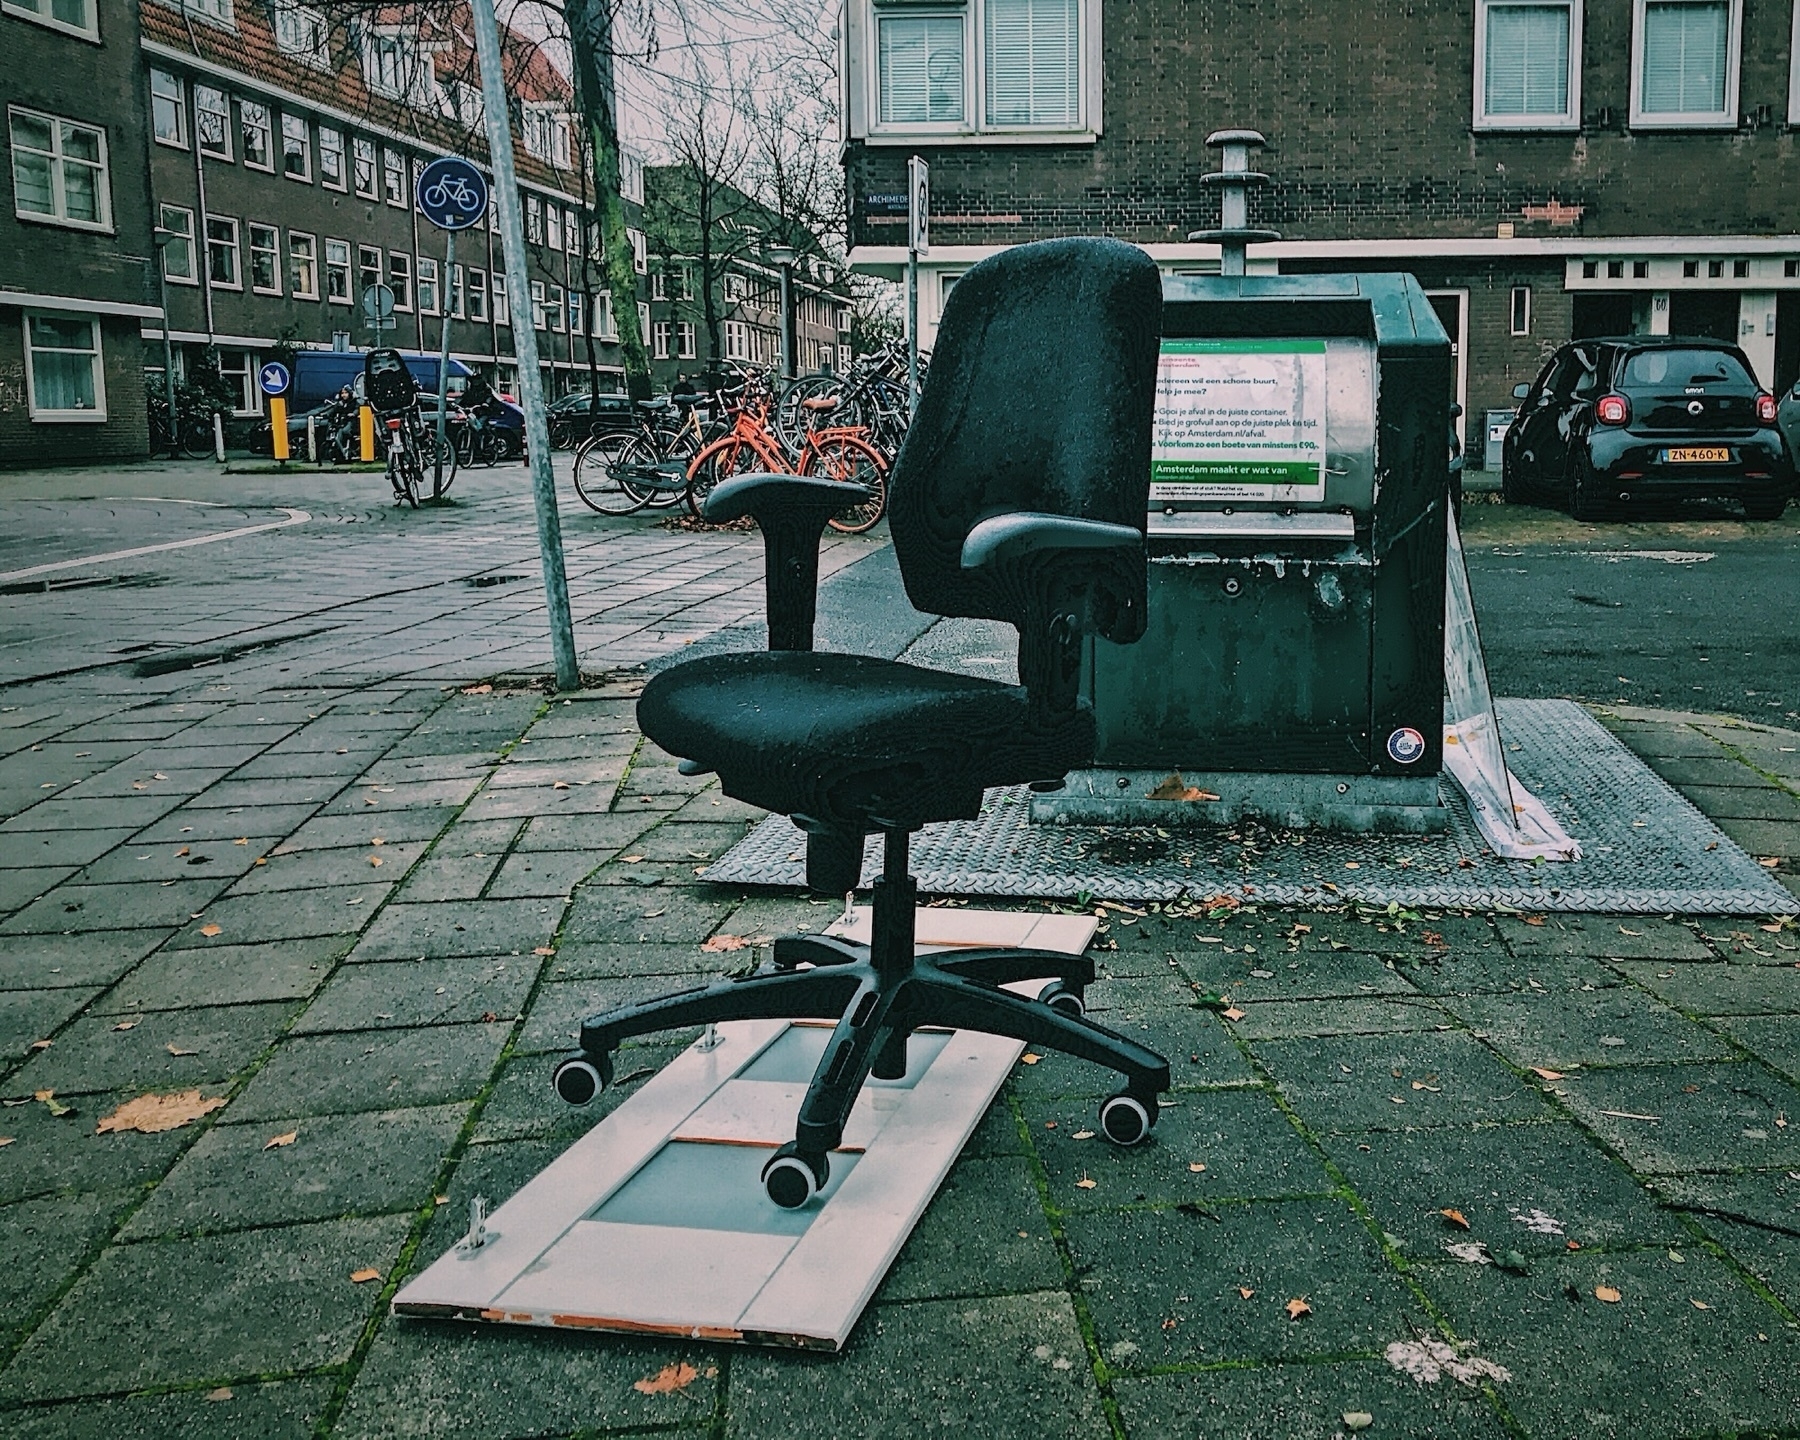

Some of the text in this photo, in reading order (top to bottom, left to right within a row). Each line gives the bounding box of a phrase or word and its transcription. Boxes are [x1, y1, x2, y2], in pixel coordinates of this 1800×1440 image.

[868, 196, 909, 204] ARCHIMEDE
[1656, 298, 1666, 311] 60
[1174, 388, 1182, 396] je
[1179, 408, 1186, 416] je
[1177, 419, 1184, 427] je
[1186, 418, 1213, 427] grofvuil
[1253, 420, 1273, 428] juiste
[1274, 419, 1291, 428] plek
[1304, 420, 1318, 428] tijd.
[1159, 429, 1172, 438] Kijk
[1188, 429, 1266, 437] Amsterdam.nl/afval.
[1672, 450, 1725, 460] ZN-460-K
[1156, 464, 1208, 474] Amsterdam
[1210, 465, 1238, 474] maakt
